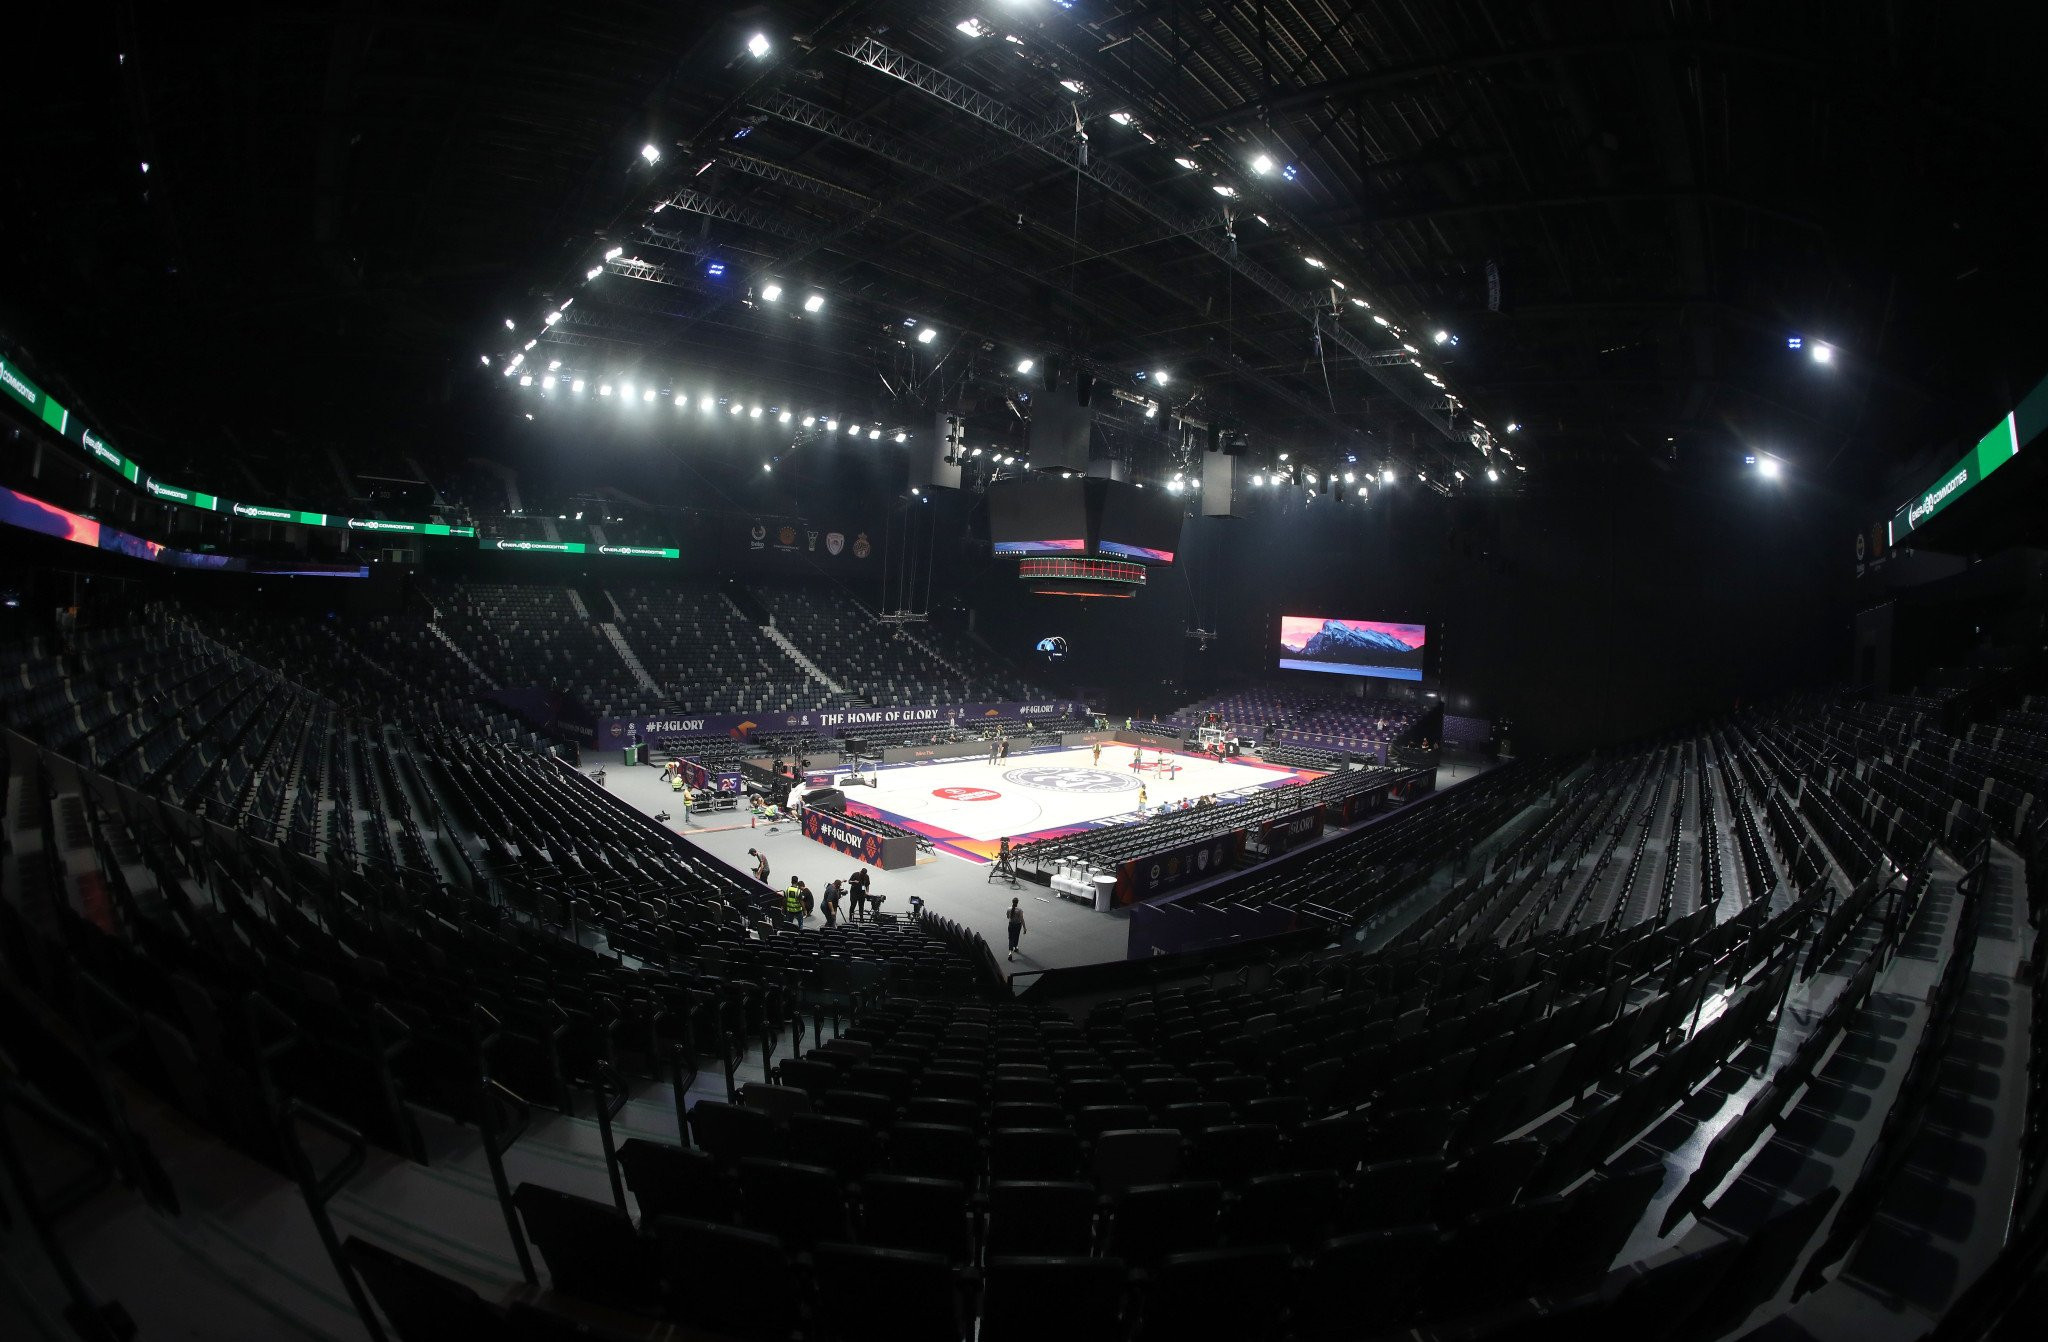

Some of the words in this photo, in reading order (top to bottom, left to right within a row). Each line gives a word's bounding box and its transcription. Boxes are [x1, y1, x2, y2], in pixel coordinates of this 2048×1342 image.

[1019, 704, 1054, 714] #F4GLORY
[820, 714, 845, 726] THE
[847, 712, 883, 723] HOME
[885, 711, 901, 721] OF
[903, 709, 939, 720] GLORY
[645, 719, 705, 733] #F4GLORY
[820, 823, 863, 849] #F4GLORY
